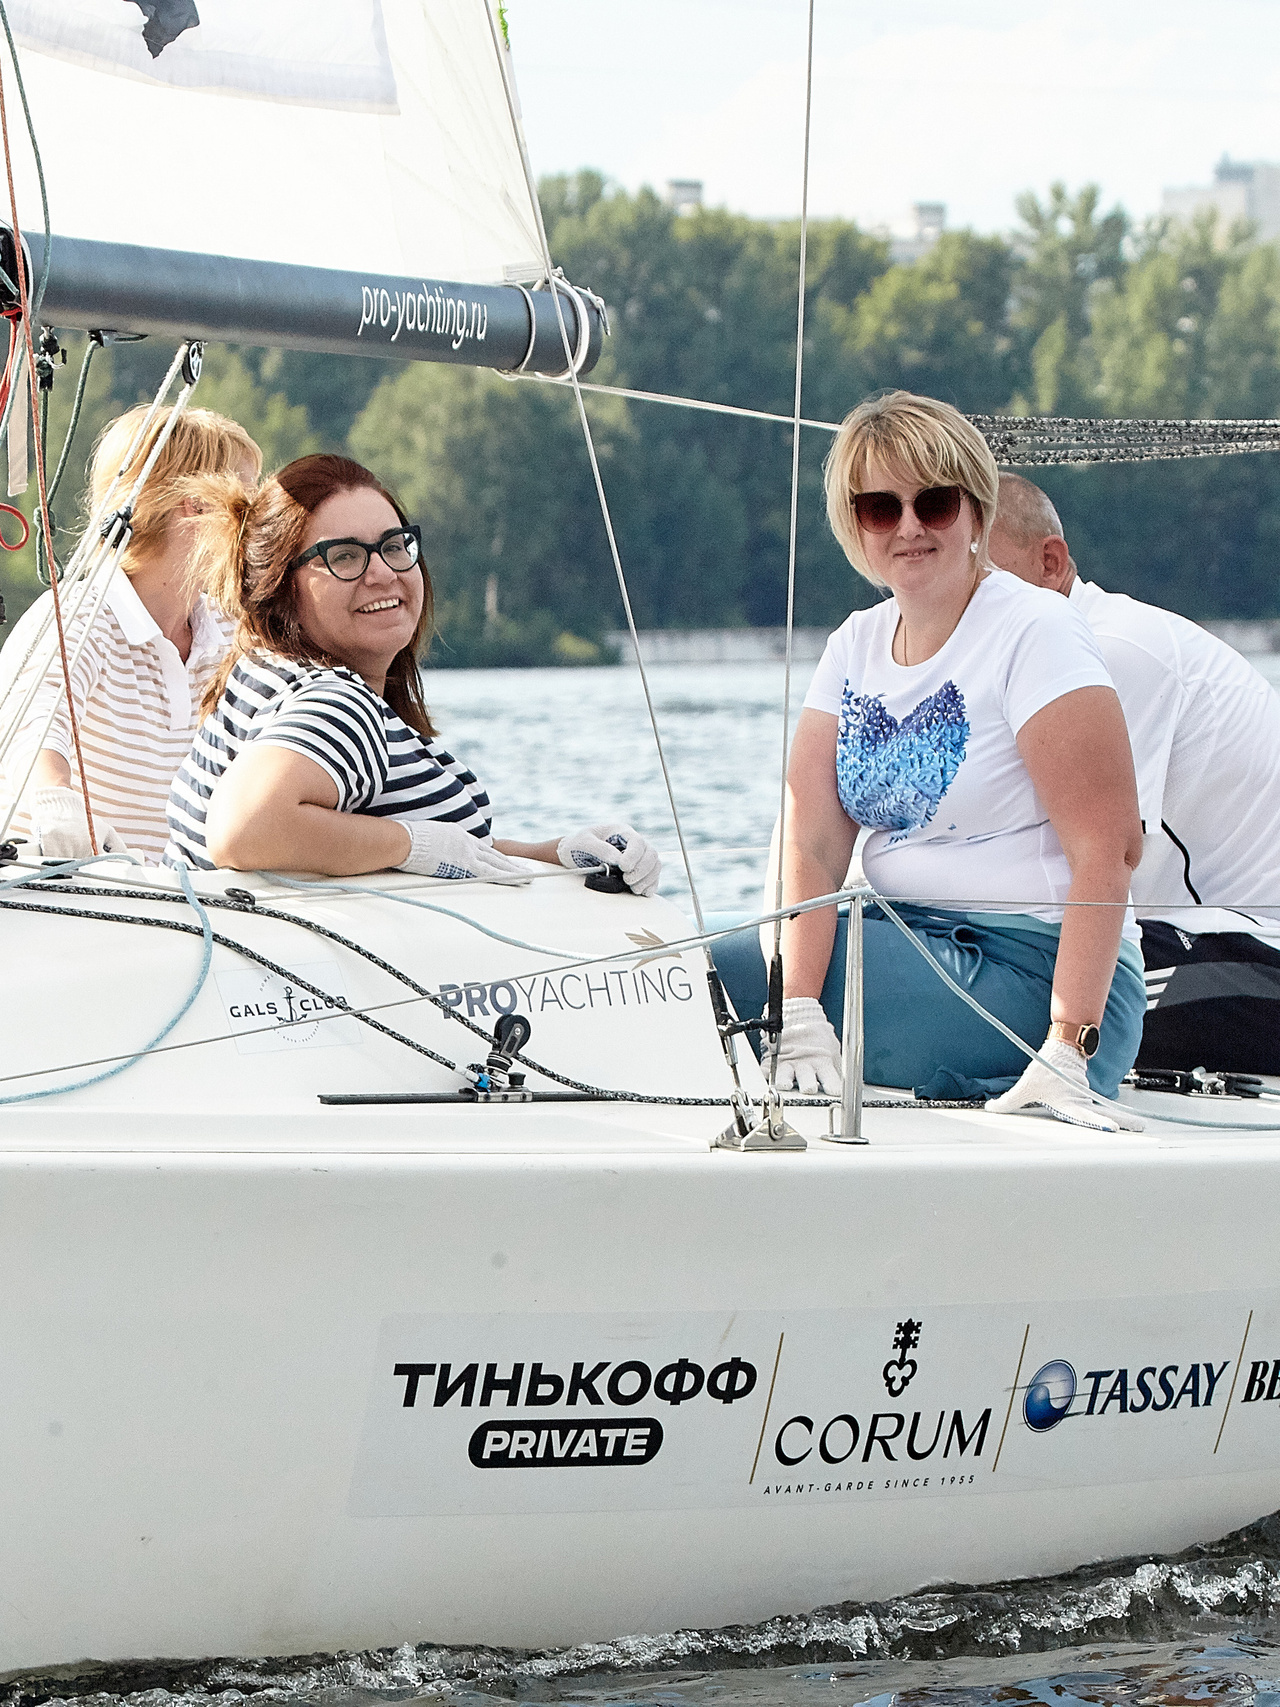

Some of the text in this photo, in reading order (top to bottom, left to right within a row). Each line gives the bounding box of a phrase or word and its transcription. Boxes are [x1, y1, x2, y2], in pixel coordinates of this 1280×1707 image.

[357, 283, 488, 350] pro-yachting.ru
[1174, 929, 1193, 951] didas
[229, 1002, 278, 1018] GALS
[438, 966, 693, 1019] PROYACHTING
[393, 1357, 758, 1408] ТИНЬКОФФ
[1083, 1360, 1231, 1416] TASSAY
[481, 1427, 651, 1459] PRIVATE
[774, 1408, 992, 1466] CORUM
[763, 1475, 975, 1495] AVANT-GARDE SINCE 1955
